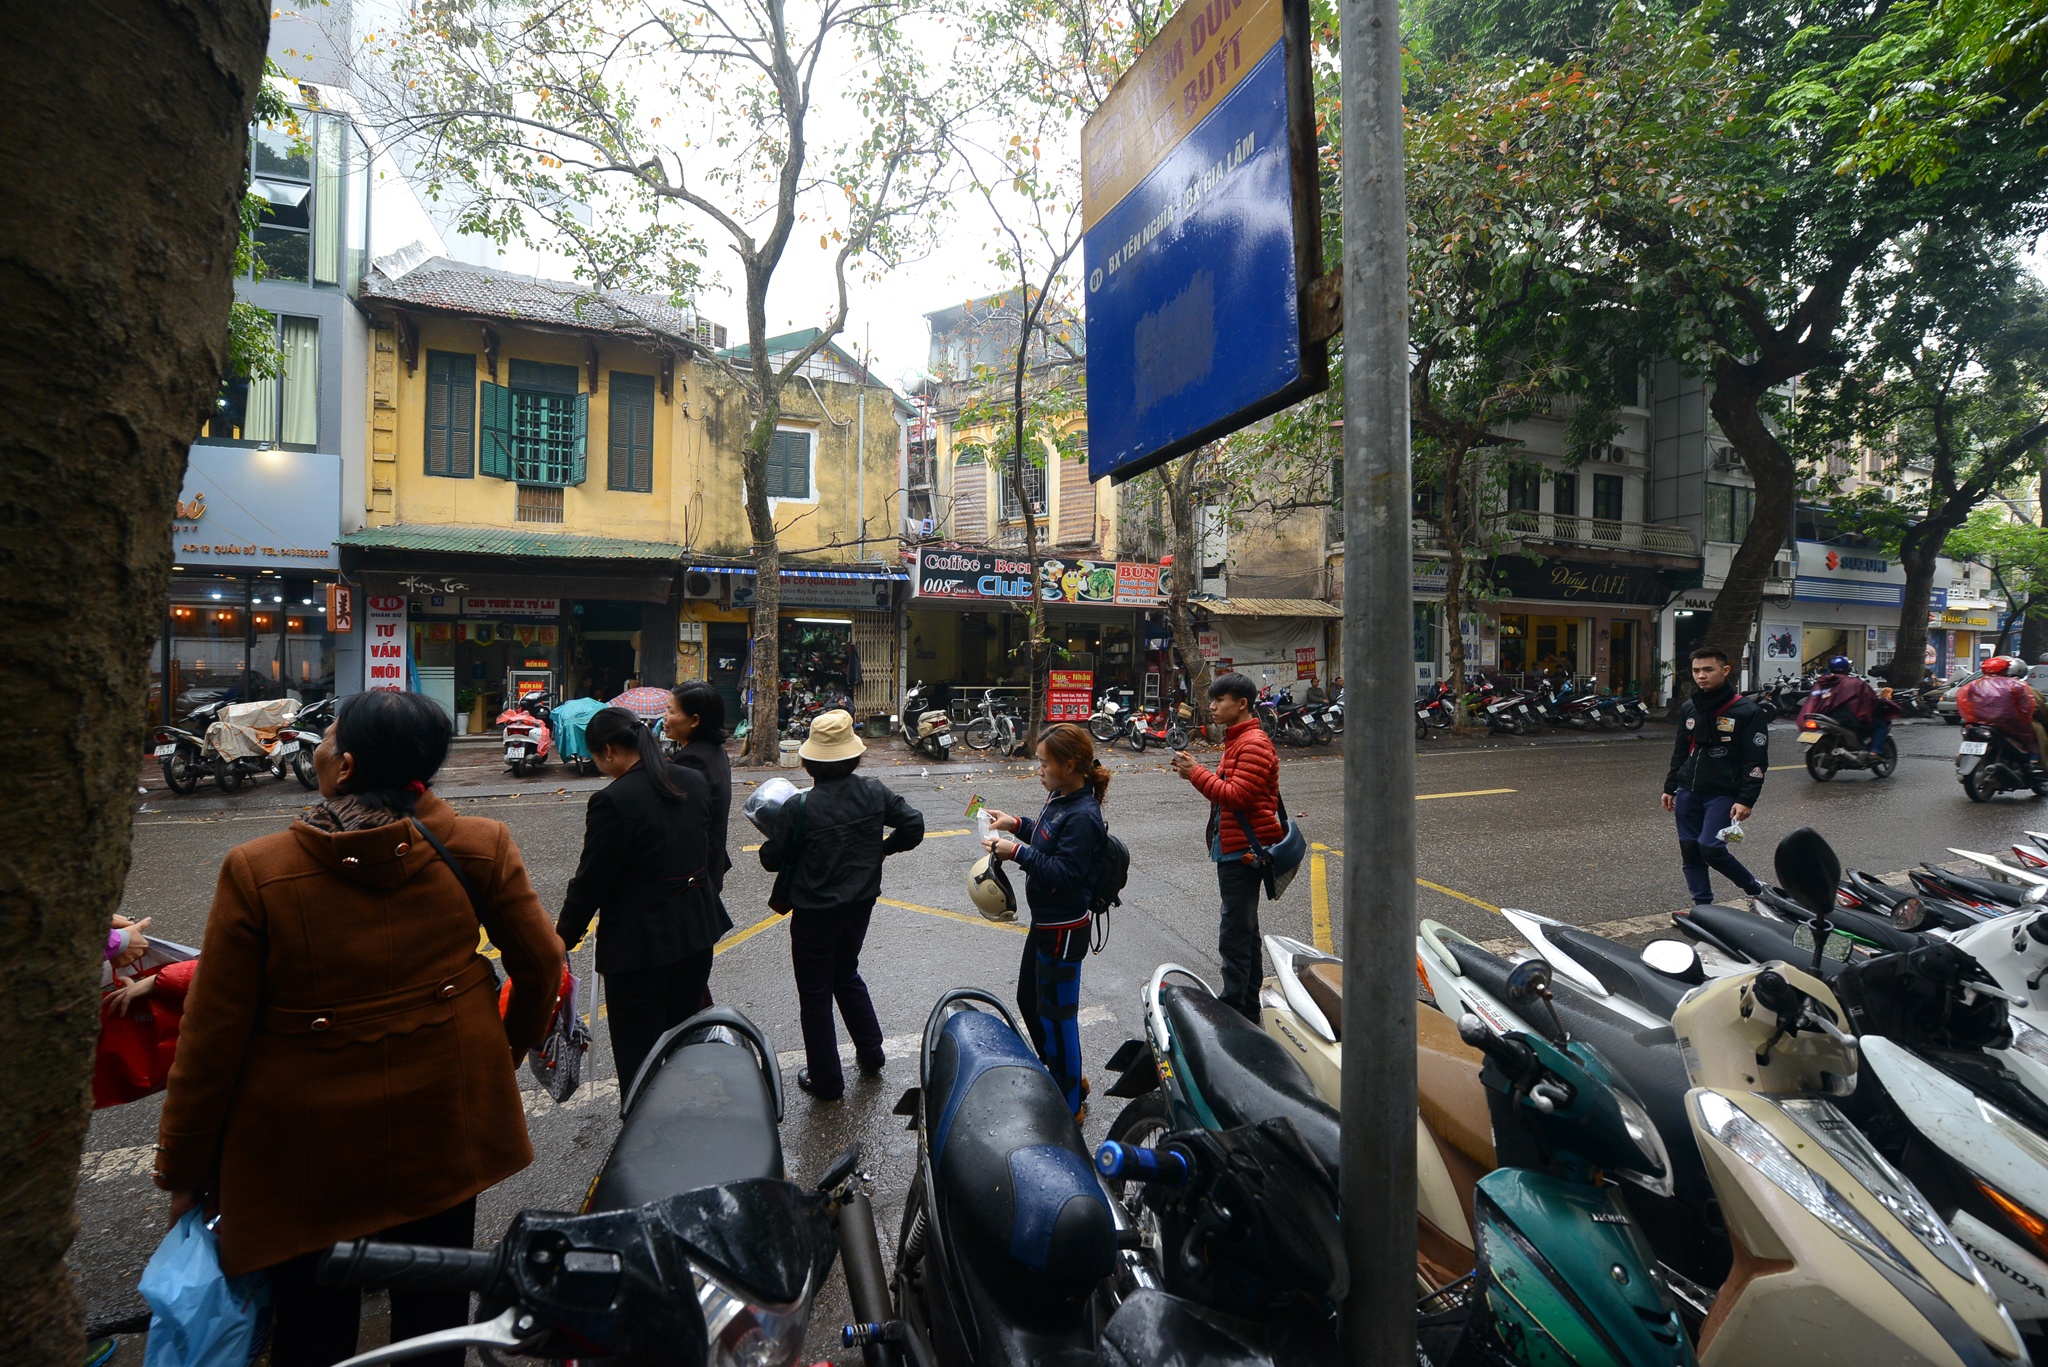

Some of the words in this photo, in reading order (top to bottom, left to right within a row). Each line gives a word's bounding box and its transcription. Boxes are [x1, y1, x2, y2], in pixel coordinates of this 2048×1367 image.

[1151, 103, 1178, 155] XE
[1183, 27, 1244, 121] BUÝT
[1108, 252, 1120, 276] BX
[1123, 232, 1140, 262] YÊN
[1185, 181, 1200, 209] BX
[1203, 161, 1224, 194] GIA
[1227, 131, 1255, 174] LÂM
[213, 543, 241, 555] QUÁN
[924, 554, 980, 572] Coffee
[1840, 556, 1887, 573] SUZUKI
[1119, 565, 1157, 580] BÚN
[923, 577, 952, 594] 008
[977, 575, 1033, 597] Club
[1591, 573, 1629, 595] CAFÉ
[378, 598, 398, 609] 10
[1684, 599, 1708, 609] NAM
[371, 641, 401, 658] VẤN
[371, 664, 400, 678] MÔI
[1420, 665, 1431, 679] NHÀ
[1957, 1237, 2047, 1298] HONDA
